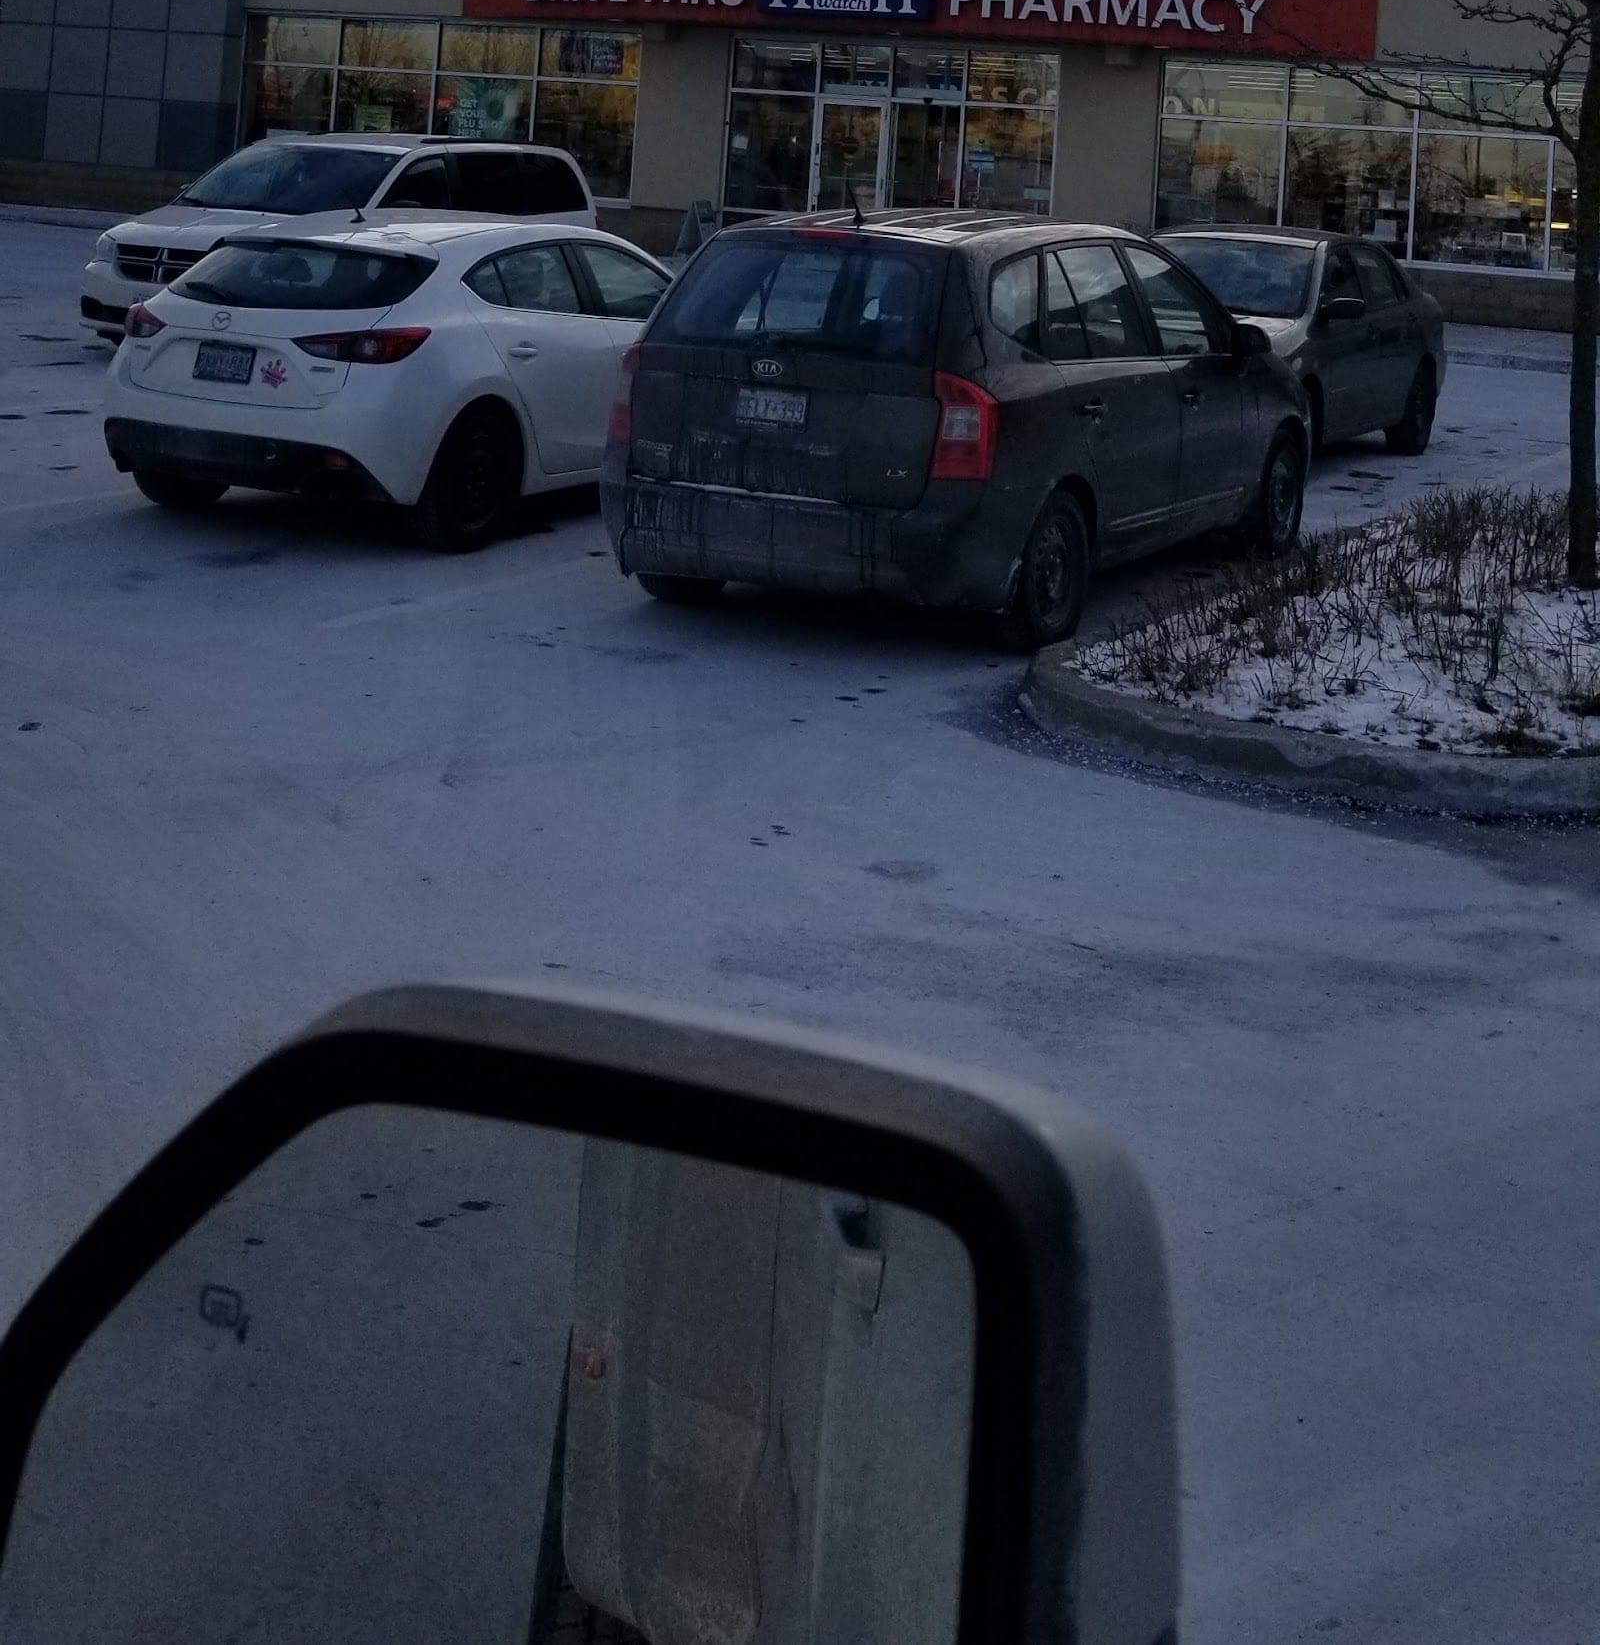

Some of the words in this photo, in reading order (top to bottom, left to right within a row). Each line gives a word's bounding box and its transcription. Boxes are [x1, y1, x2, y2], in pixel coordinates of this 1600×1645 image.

[460, 98, 478, 109] GET
[458, 118, 476, 129] FLU
[757, 362, 777, 373] KIA
